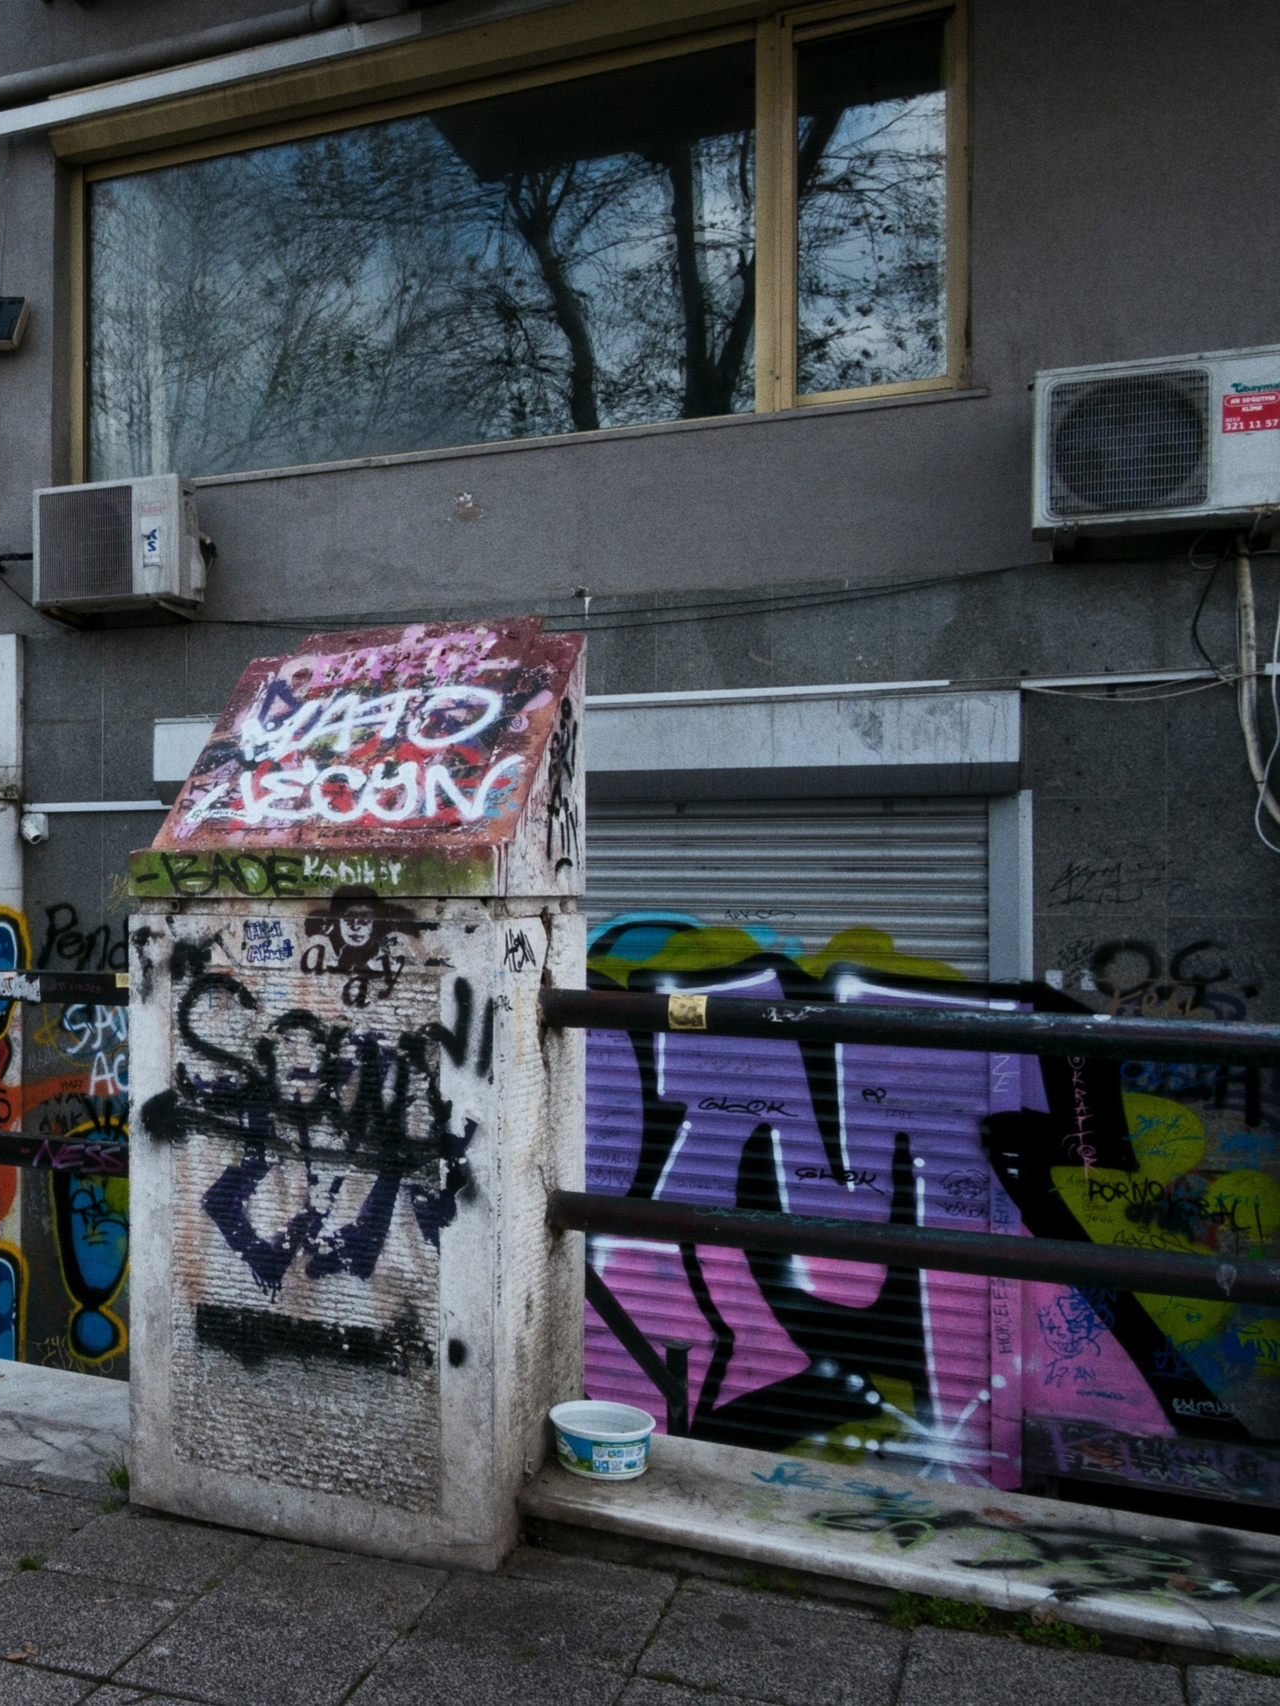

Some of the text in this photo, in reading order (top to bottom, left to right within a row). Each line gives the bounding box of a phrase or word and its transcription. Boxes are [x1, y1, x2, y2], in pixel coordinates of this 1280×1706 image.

[1225, 418, 1279, 431] 321 11 57
